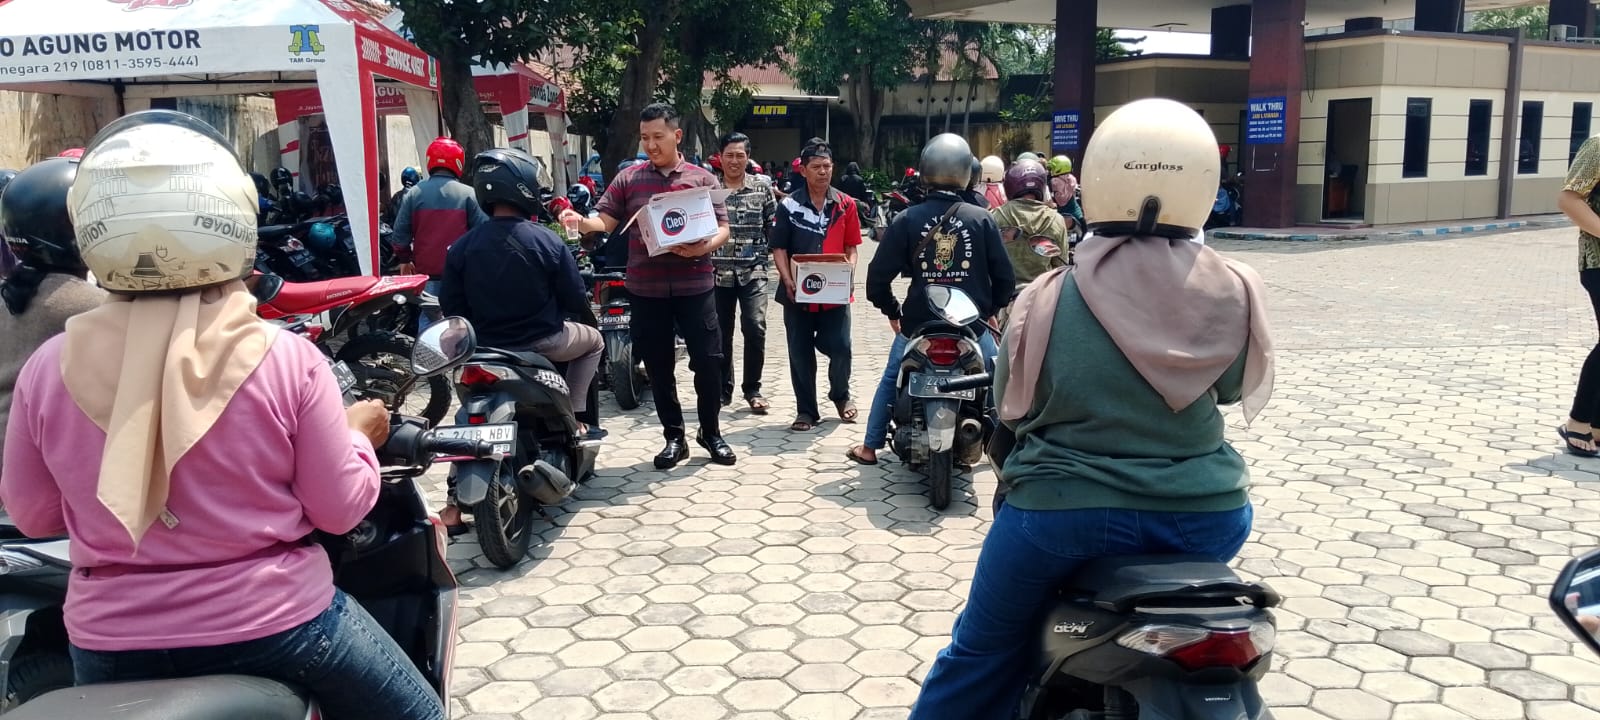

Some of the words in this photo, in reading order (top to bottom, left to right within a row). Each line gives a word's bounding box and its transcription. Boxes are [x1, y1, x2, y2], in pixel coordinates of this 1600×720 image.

[22, 34, 107, 57] AGUNG
[115, 29, 202, 52] MOTOR
[53, 61, 78, 73] 219
[82, 55, 199, 72] (0811-3595-444)
[1250, 103, 1267, 112] WALK
[1268, 102, 1284, 111] THRU
[1054, 115, 1067, 123] DRIVE
[1067, 114, 1079, 122] THRU
[1123, 161, 1184, 172] Cargloss
[665, 215, 684, 229] Cleo
[961, 229, 973, 258] MIND
[806, 278, 823, 289] Cleo
[911, 375, 918, 384] S
[489, 428, 511, 441] NBV
